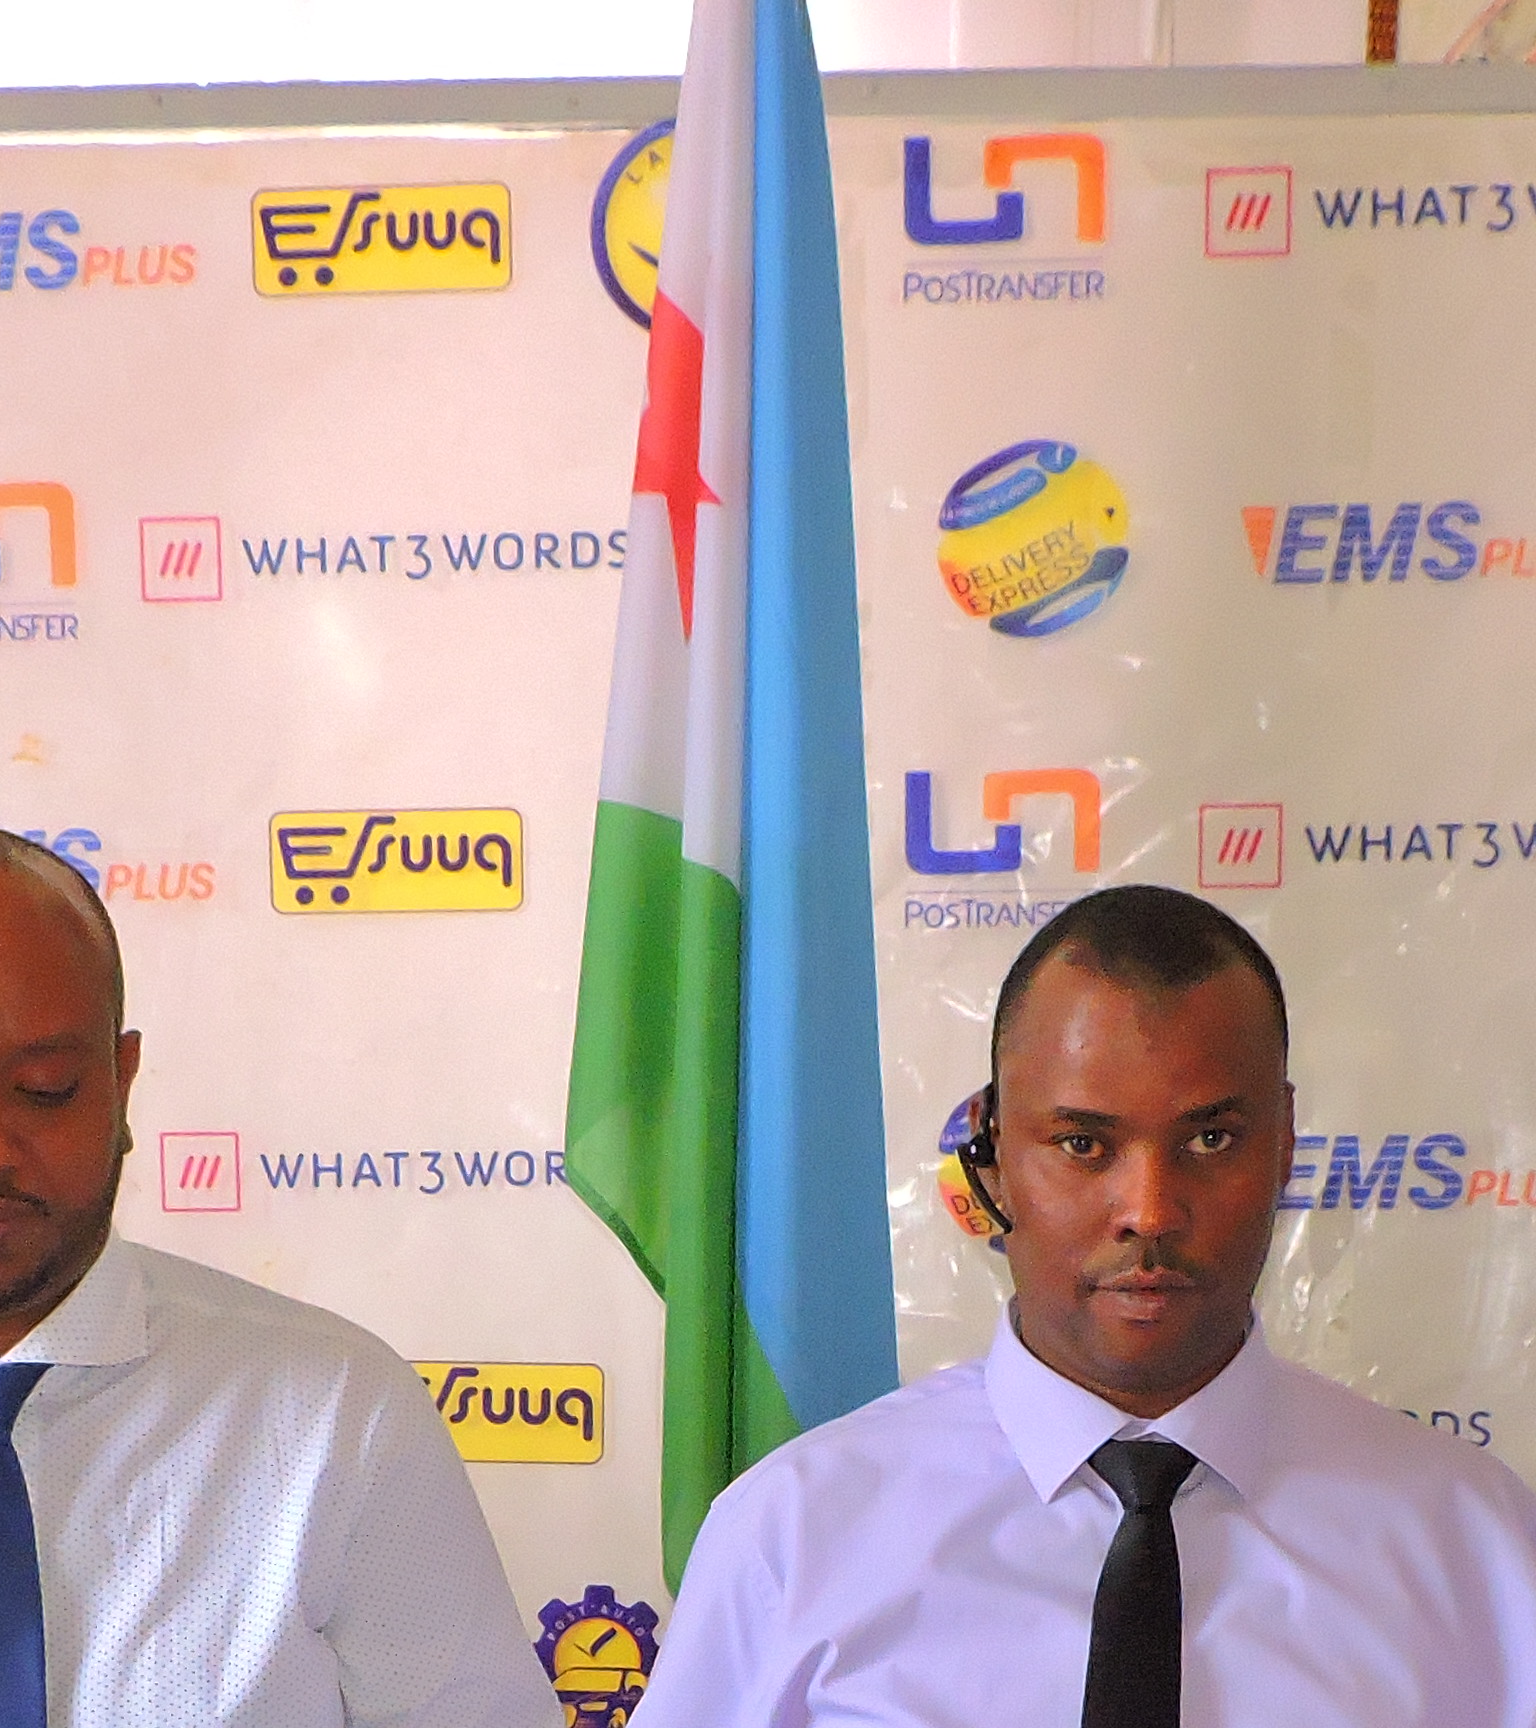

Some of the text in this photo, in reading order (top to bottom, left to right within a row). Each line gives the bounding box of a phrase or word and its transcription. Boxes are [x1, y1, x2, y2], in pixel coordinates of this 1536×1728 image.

[82, 245, 196, 287] PLUS
[951, 520, 1076, 597] DELIVERY
[968, 542, 1090, 614] EXPRESS
[1274, 501, 1480, 584] EMS
[105, 862, 215, 902] PLUS
[260, 1150, 567, 1195] WHAT3WOR
[1276, 1134, 1467, 1211] EMS
